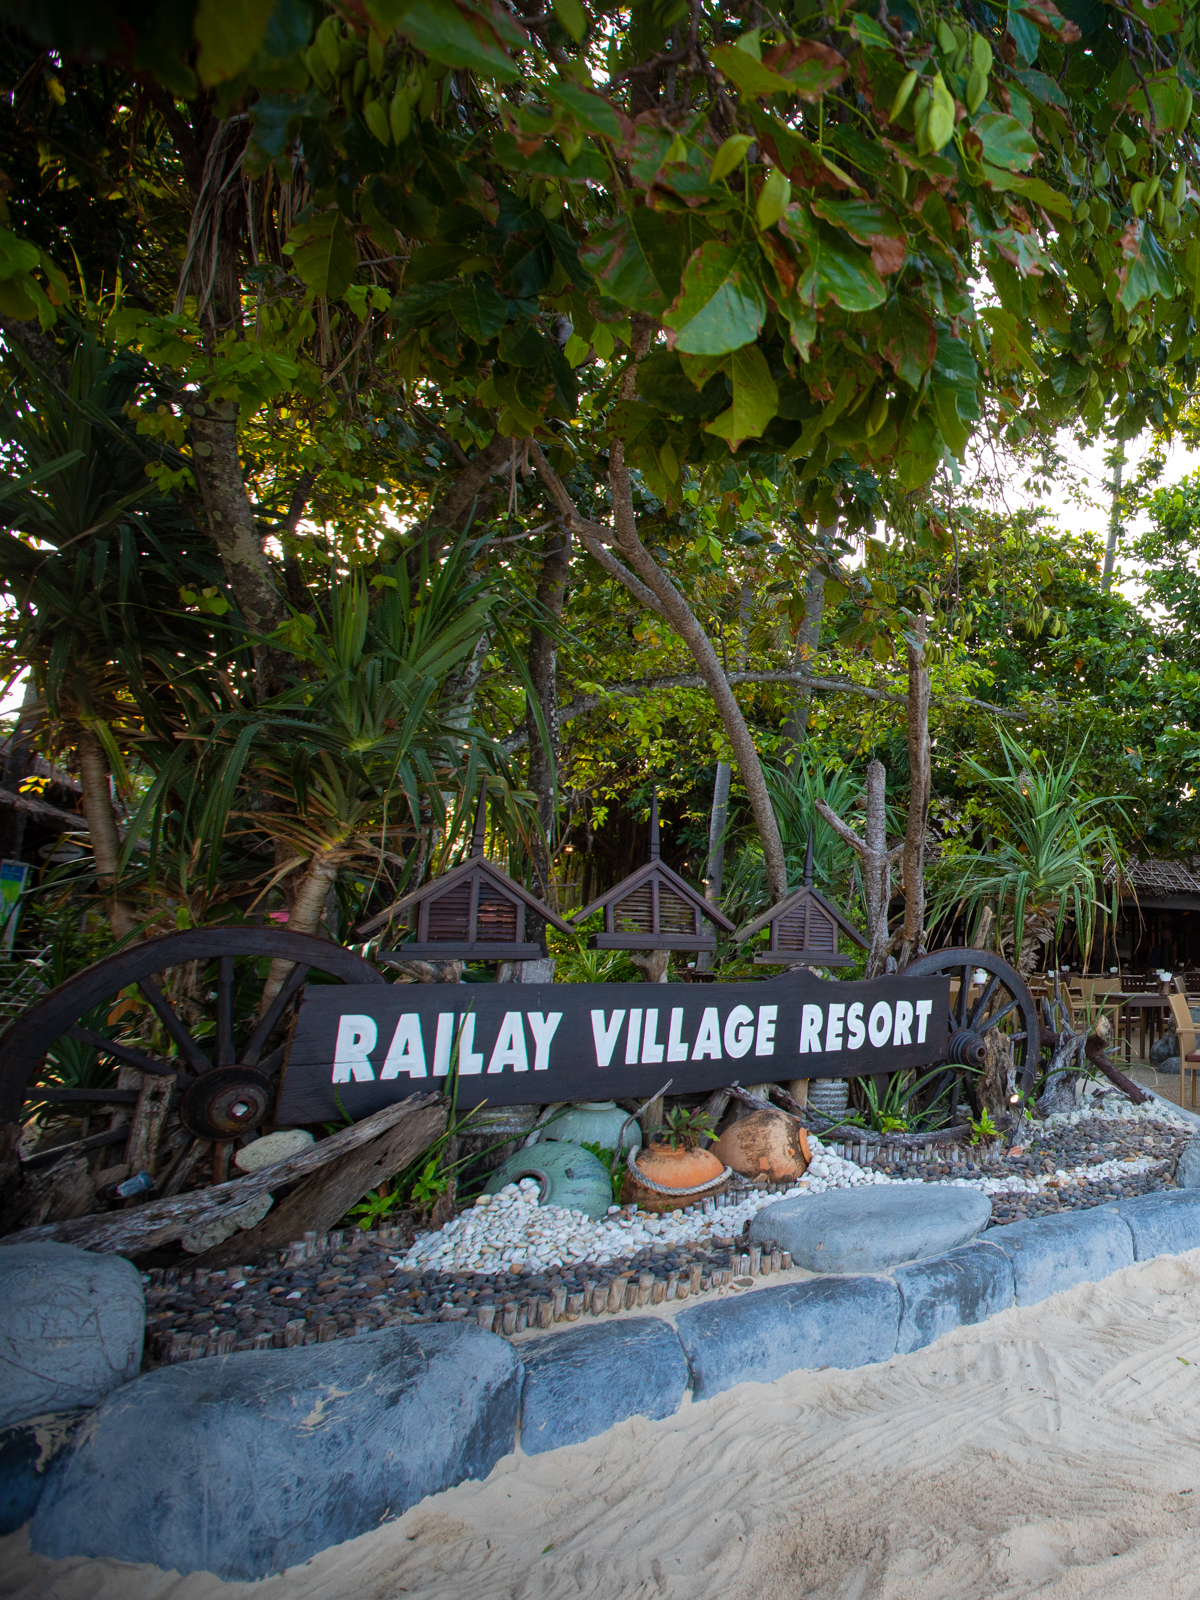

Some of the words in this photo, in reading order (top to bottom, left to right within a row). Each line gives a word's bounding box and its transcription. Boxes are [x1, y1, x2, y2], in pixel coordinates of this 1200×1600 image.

[332, 1011, 563, 1084] RAILAY
[590, 1004, 778, 1068] VILLAGE
[799, 999, 933, 1054] RESORT
